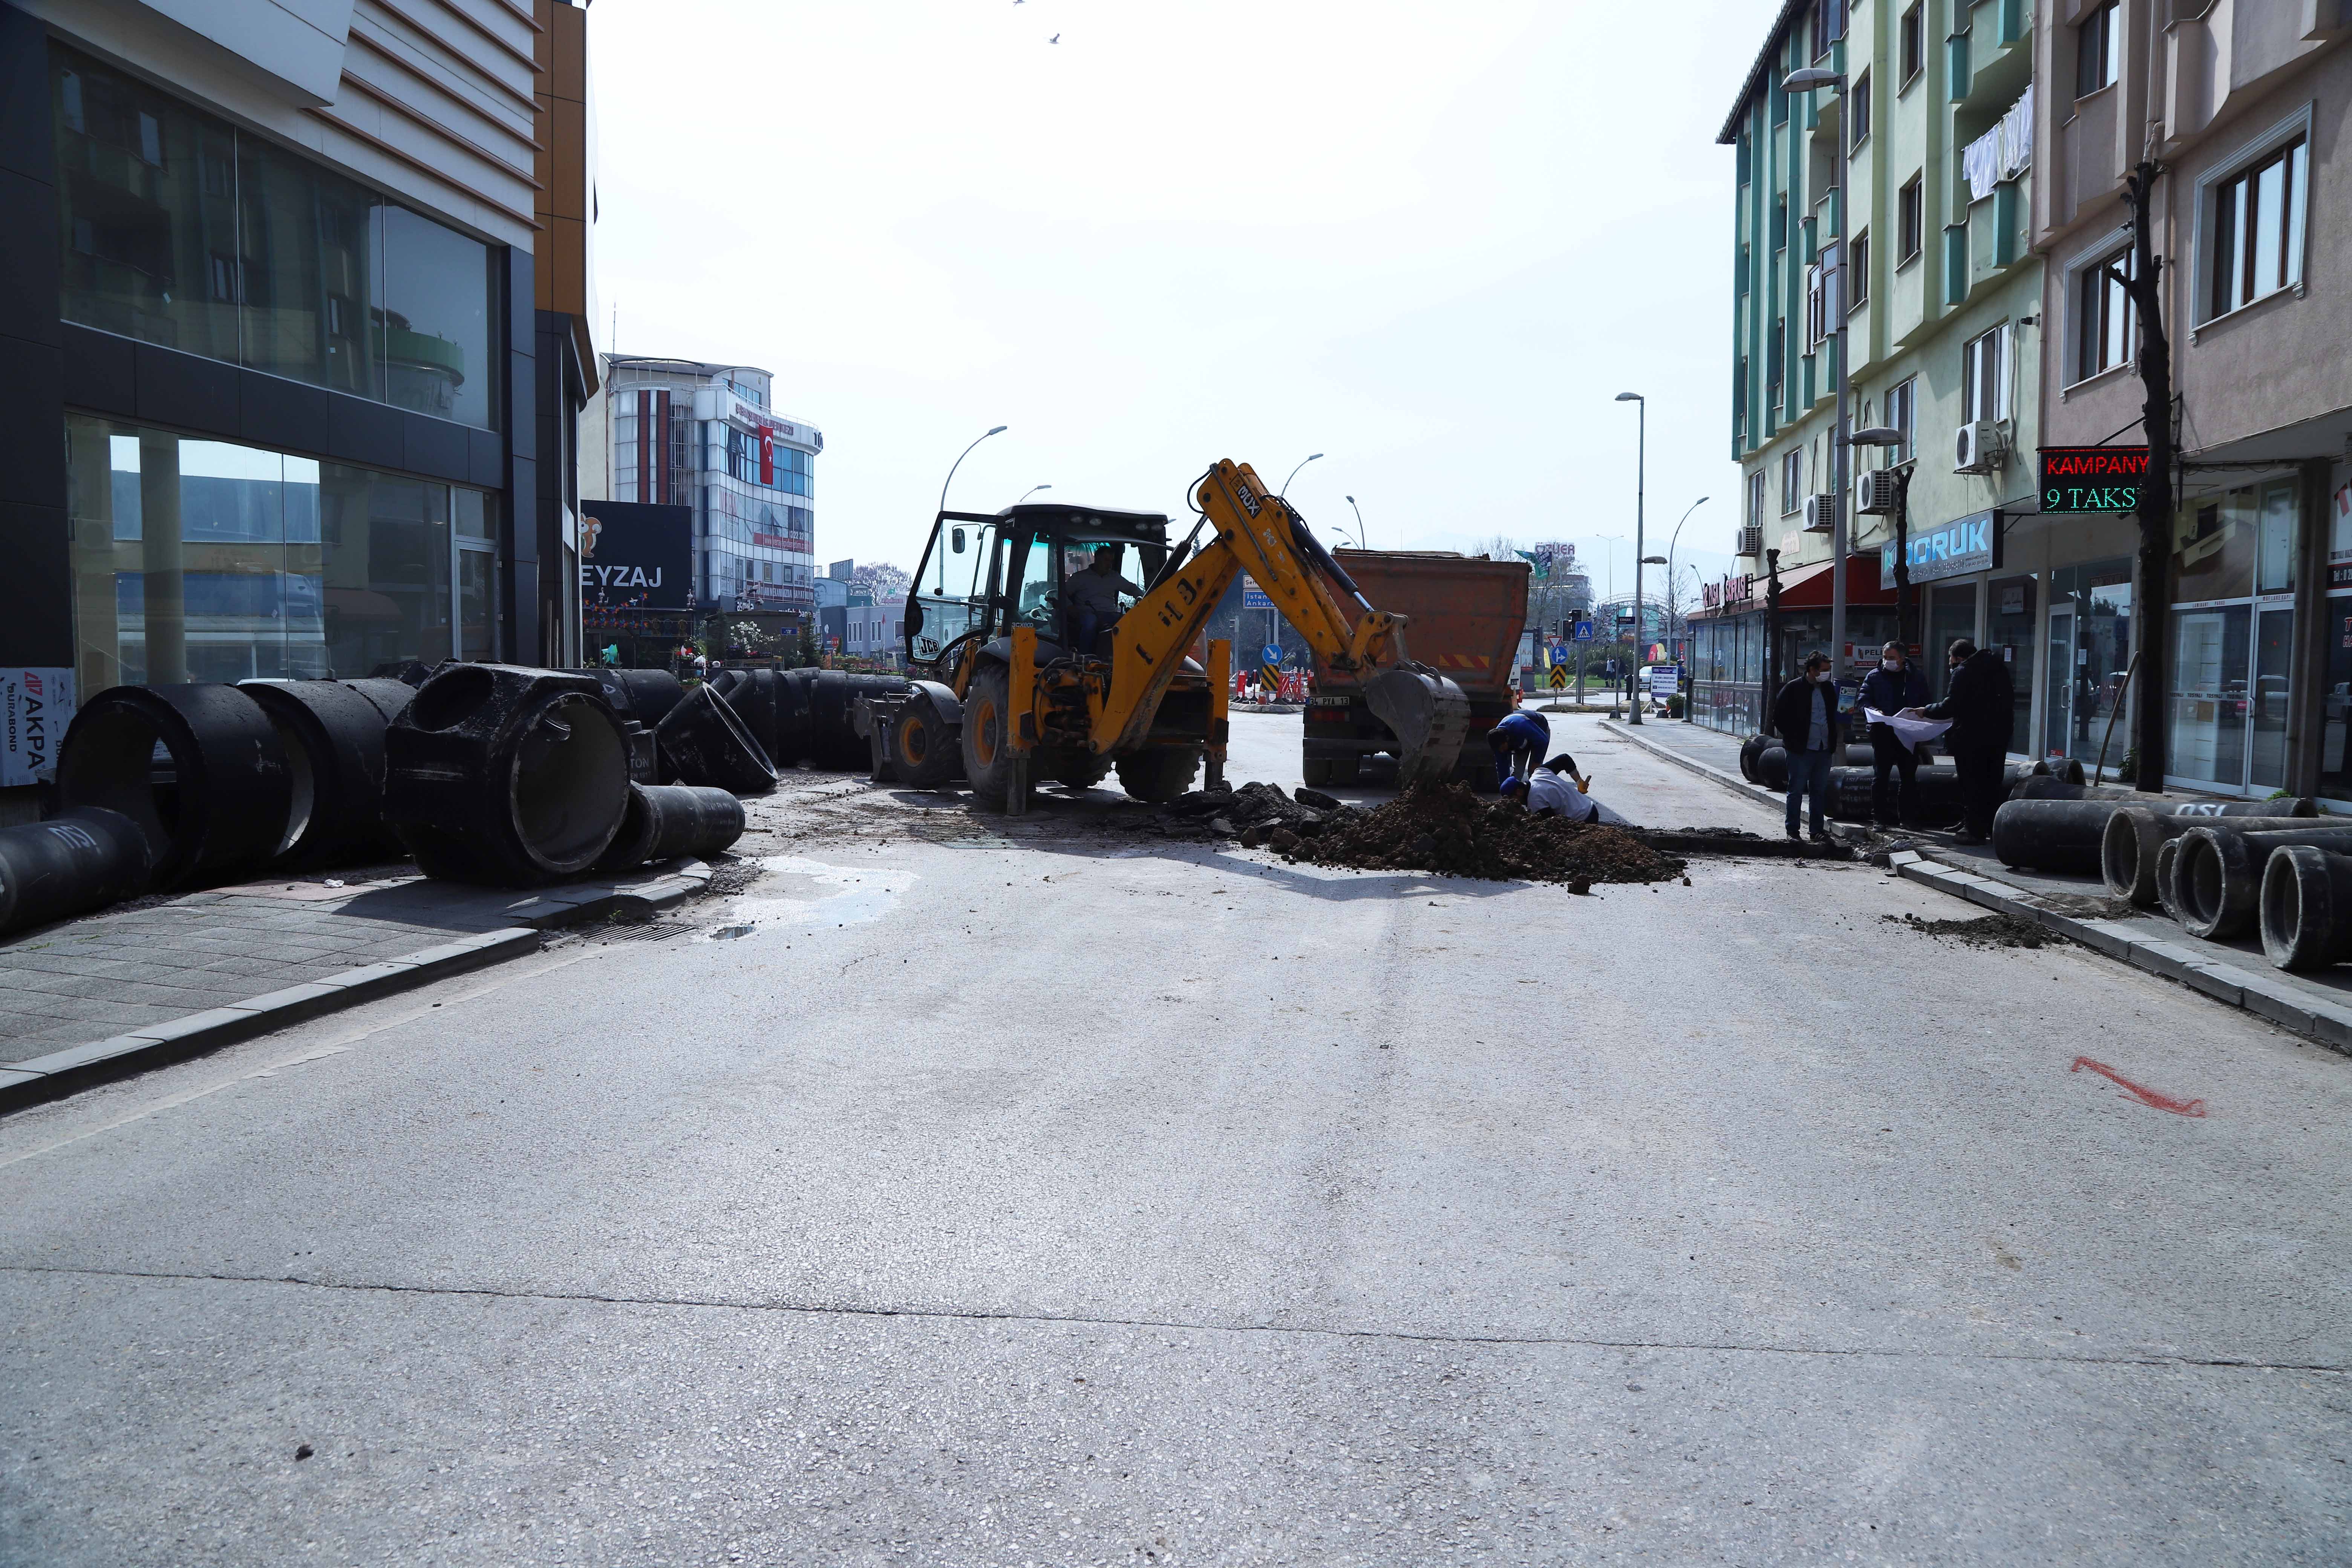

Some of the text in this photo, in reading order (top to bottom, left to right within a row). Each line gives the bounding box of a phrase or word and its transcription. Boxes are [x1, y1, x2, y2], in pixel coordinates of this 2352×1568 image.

[2047, 487, 2140, 508] 9 TAKS
[921, 638, 939, 654] JCB
[7, 685, 17, 752] DURABOND
[25, 697, 45, 770] AKPA
